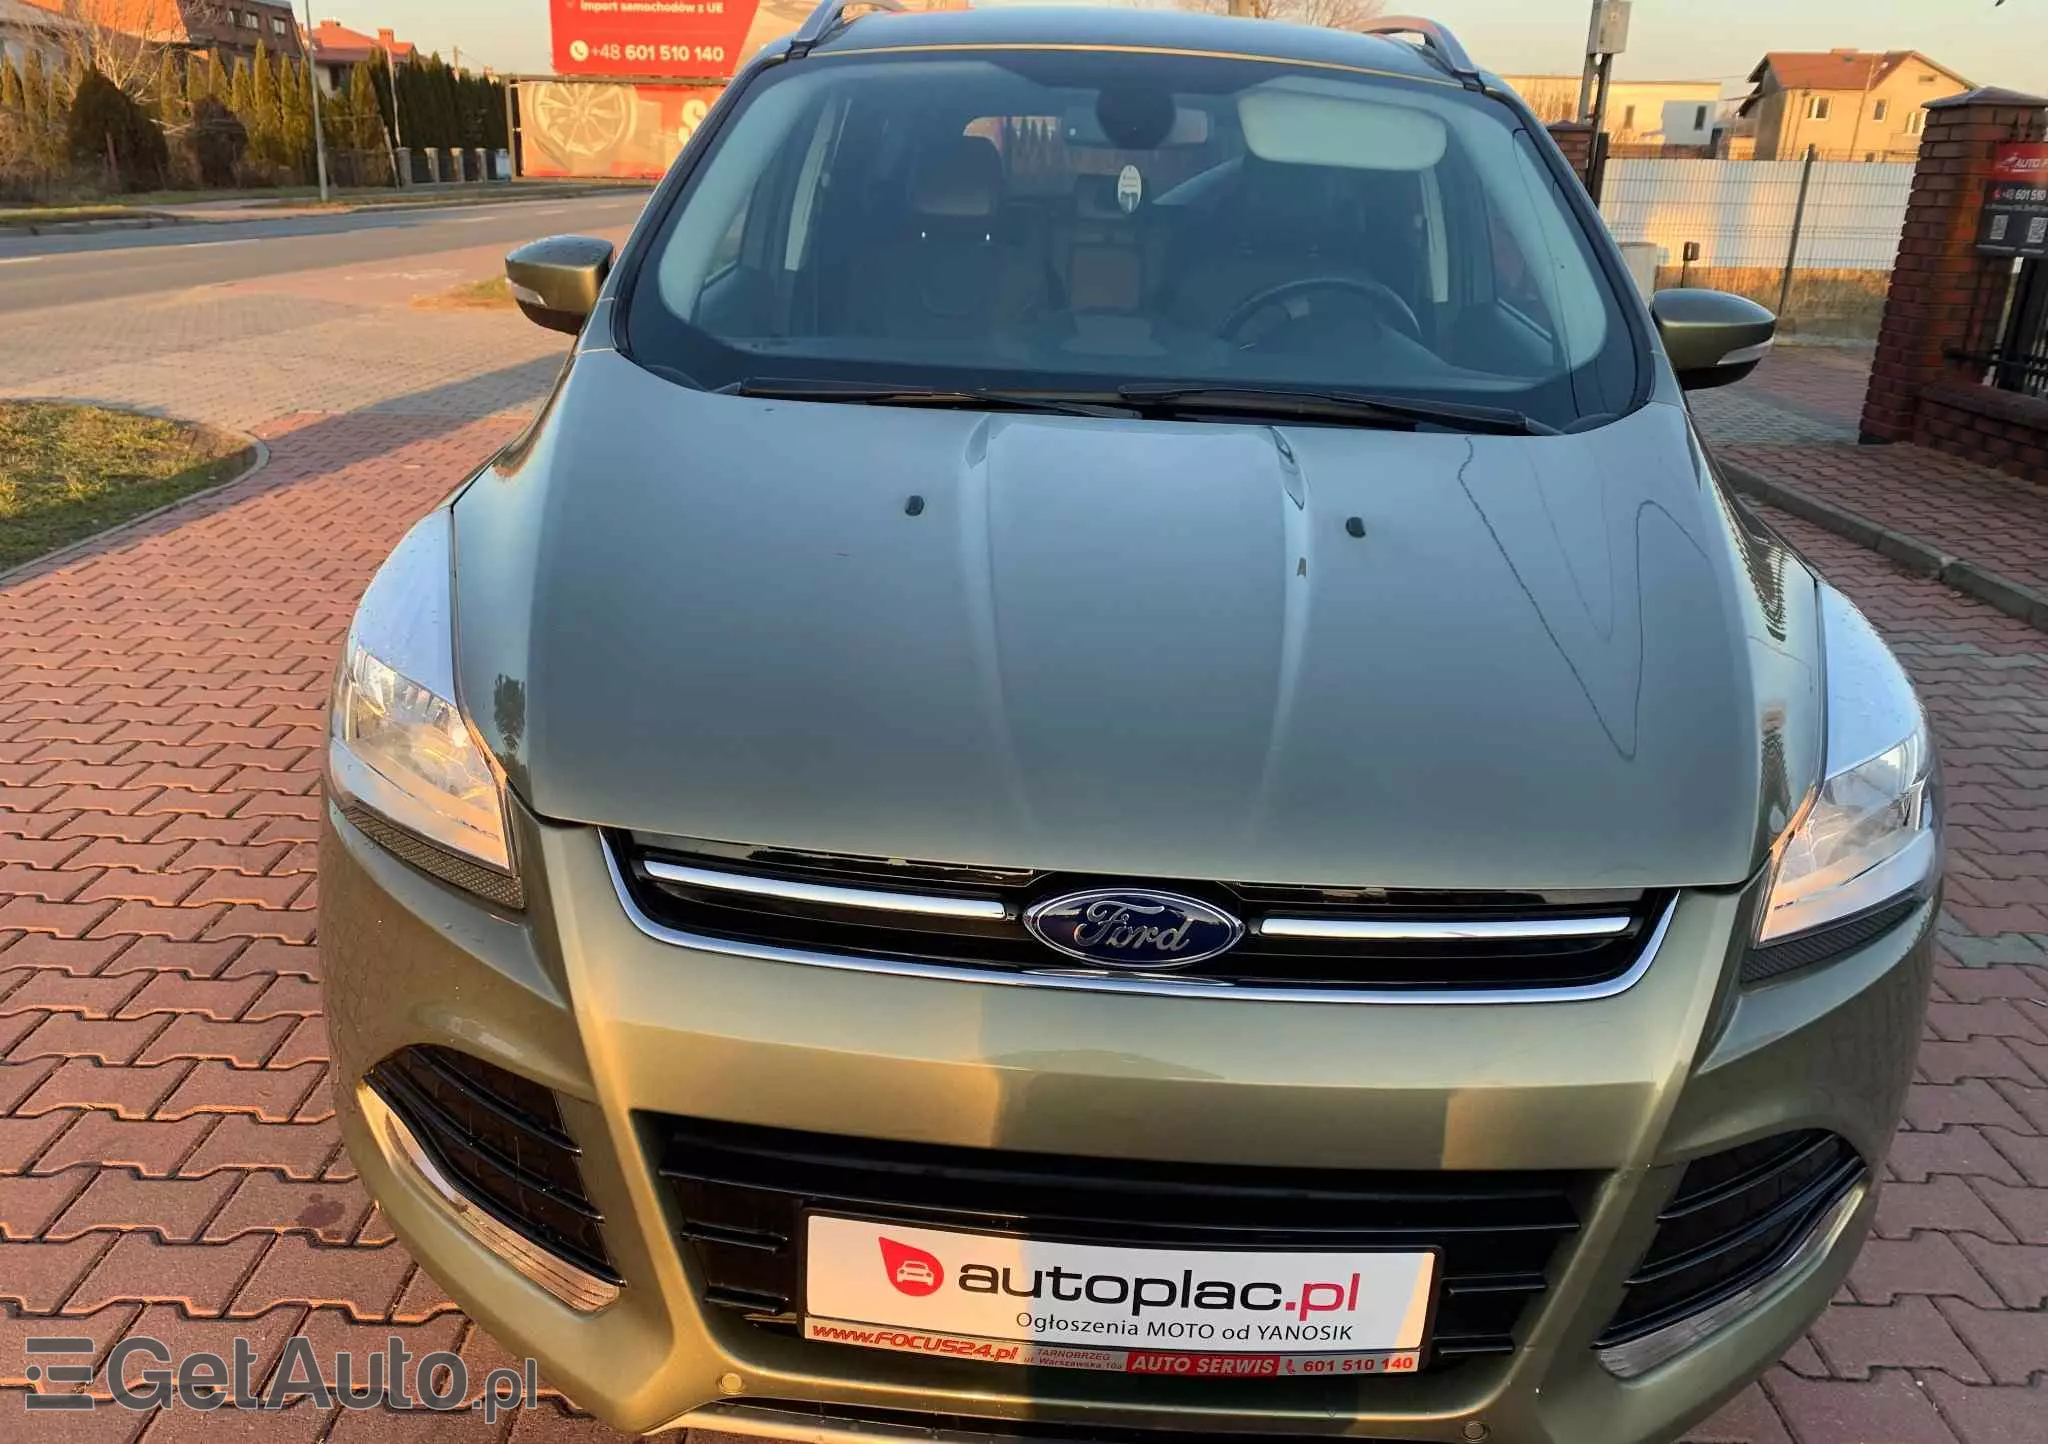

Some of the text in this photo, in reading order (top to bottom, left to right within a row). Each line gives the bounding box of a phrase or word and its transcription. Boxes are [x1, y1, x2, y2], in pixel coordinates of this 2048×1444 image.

[620, 2, 695, 13] samochodów
[707, 2, 724, 14] UE
[592, 44, 725, 62] +48 601 510 140
[1074, 900, 1192, 951] Ford
[958, 1262, 1361, 1322] autoplac.pl
[1016, 1311, 1353, 1341] Ogłoszenia MOTO od YANOSIK
[1039, 1348, 1112, 1361] TARNOBRZEG
[1132, 1355, 1274, 1374] AUTO SERWIS
[1303, 1357, 1413, 1372] 601 510 140
